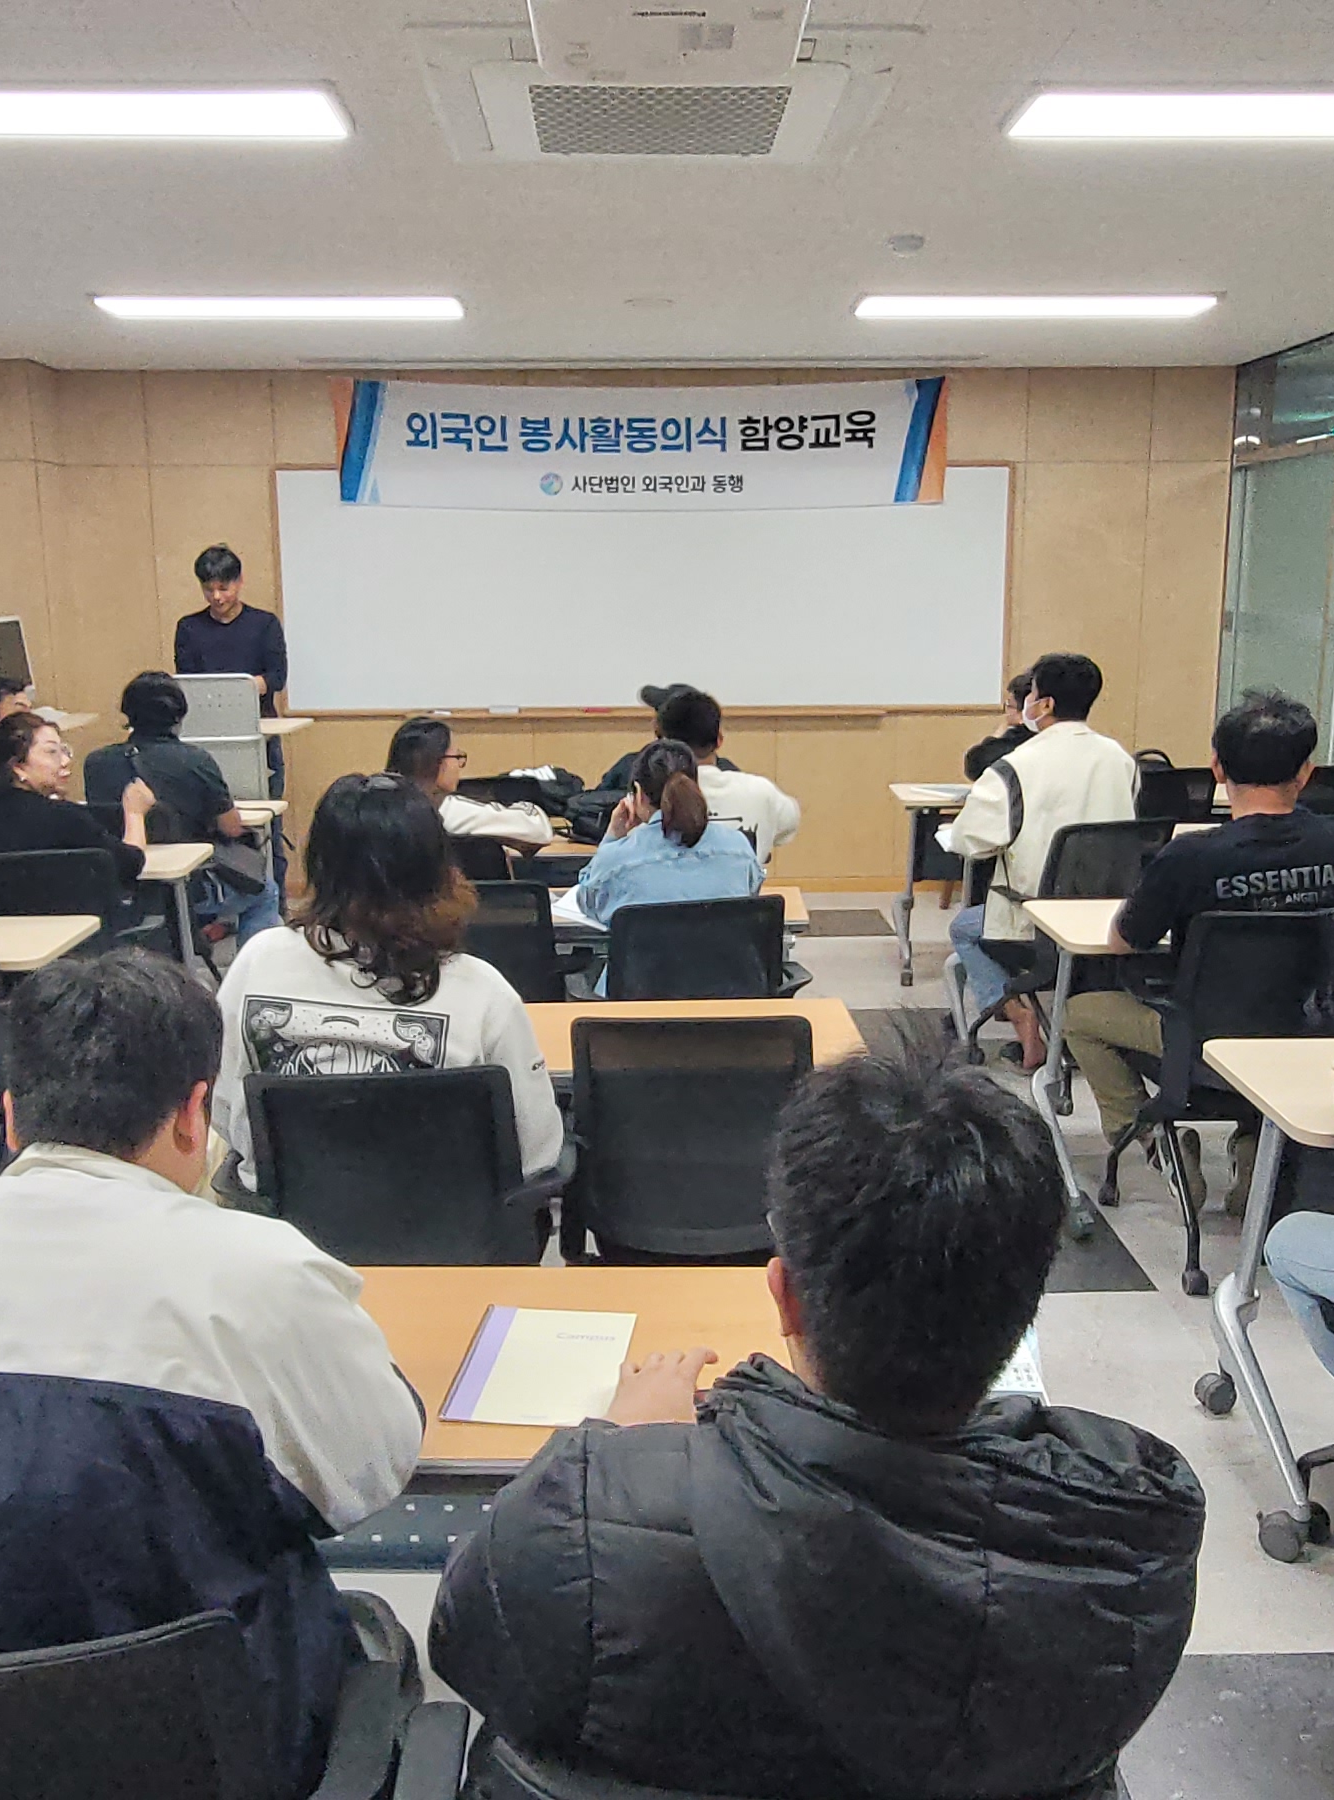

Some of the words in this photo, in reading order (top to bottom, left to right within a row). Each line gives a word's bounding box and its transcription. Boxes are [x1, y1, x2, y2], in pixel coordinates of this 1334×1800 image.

[406, 411, 508, 453] 외국인
[519, 415, 728, 453] 봉사활동의식
[738, 410, 876, 452] 함양교육
[571, 475, 636, 493] 사단법인
[642, 475, 706, 493] 외국인과
[712, 474, 744, 493] 동행
